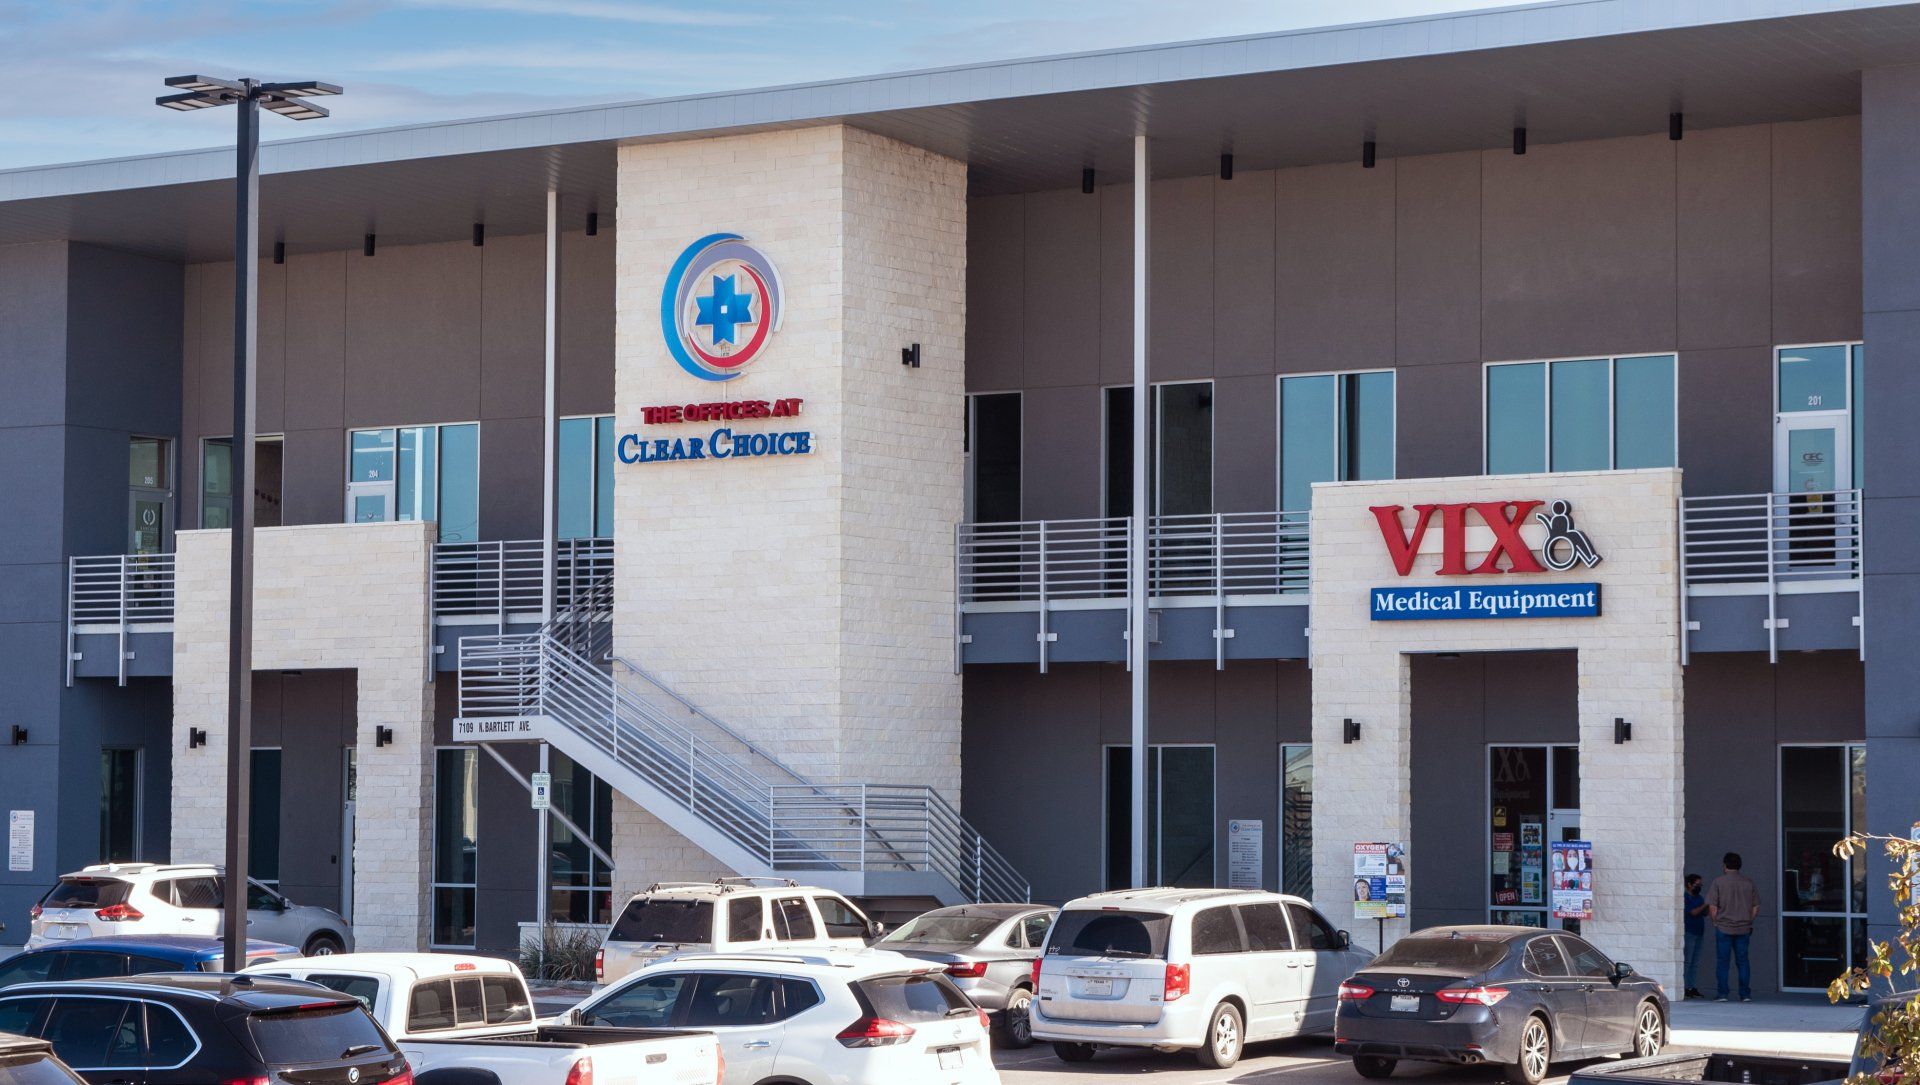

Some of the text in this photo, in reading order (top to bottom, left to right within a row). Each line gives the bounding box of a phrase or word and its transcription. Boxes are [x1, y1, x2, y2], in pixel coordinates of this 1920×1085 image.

[641, 398, 803, 424] THE OFFICES AT
[1808, 395, 1822, 407] 201
[618, 428, 812, 464] CLEAR CHOICE
[1369, 500, 1548, 577] VIX
[1376, 590, 1595, 615] Medical Equipment
[458, 722, 474, 734] 7109
[1499, 891, 1516, 902] OPEN
